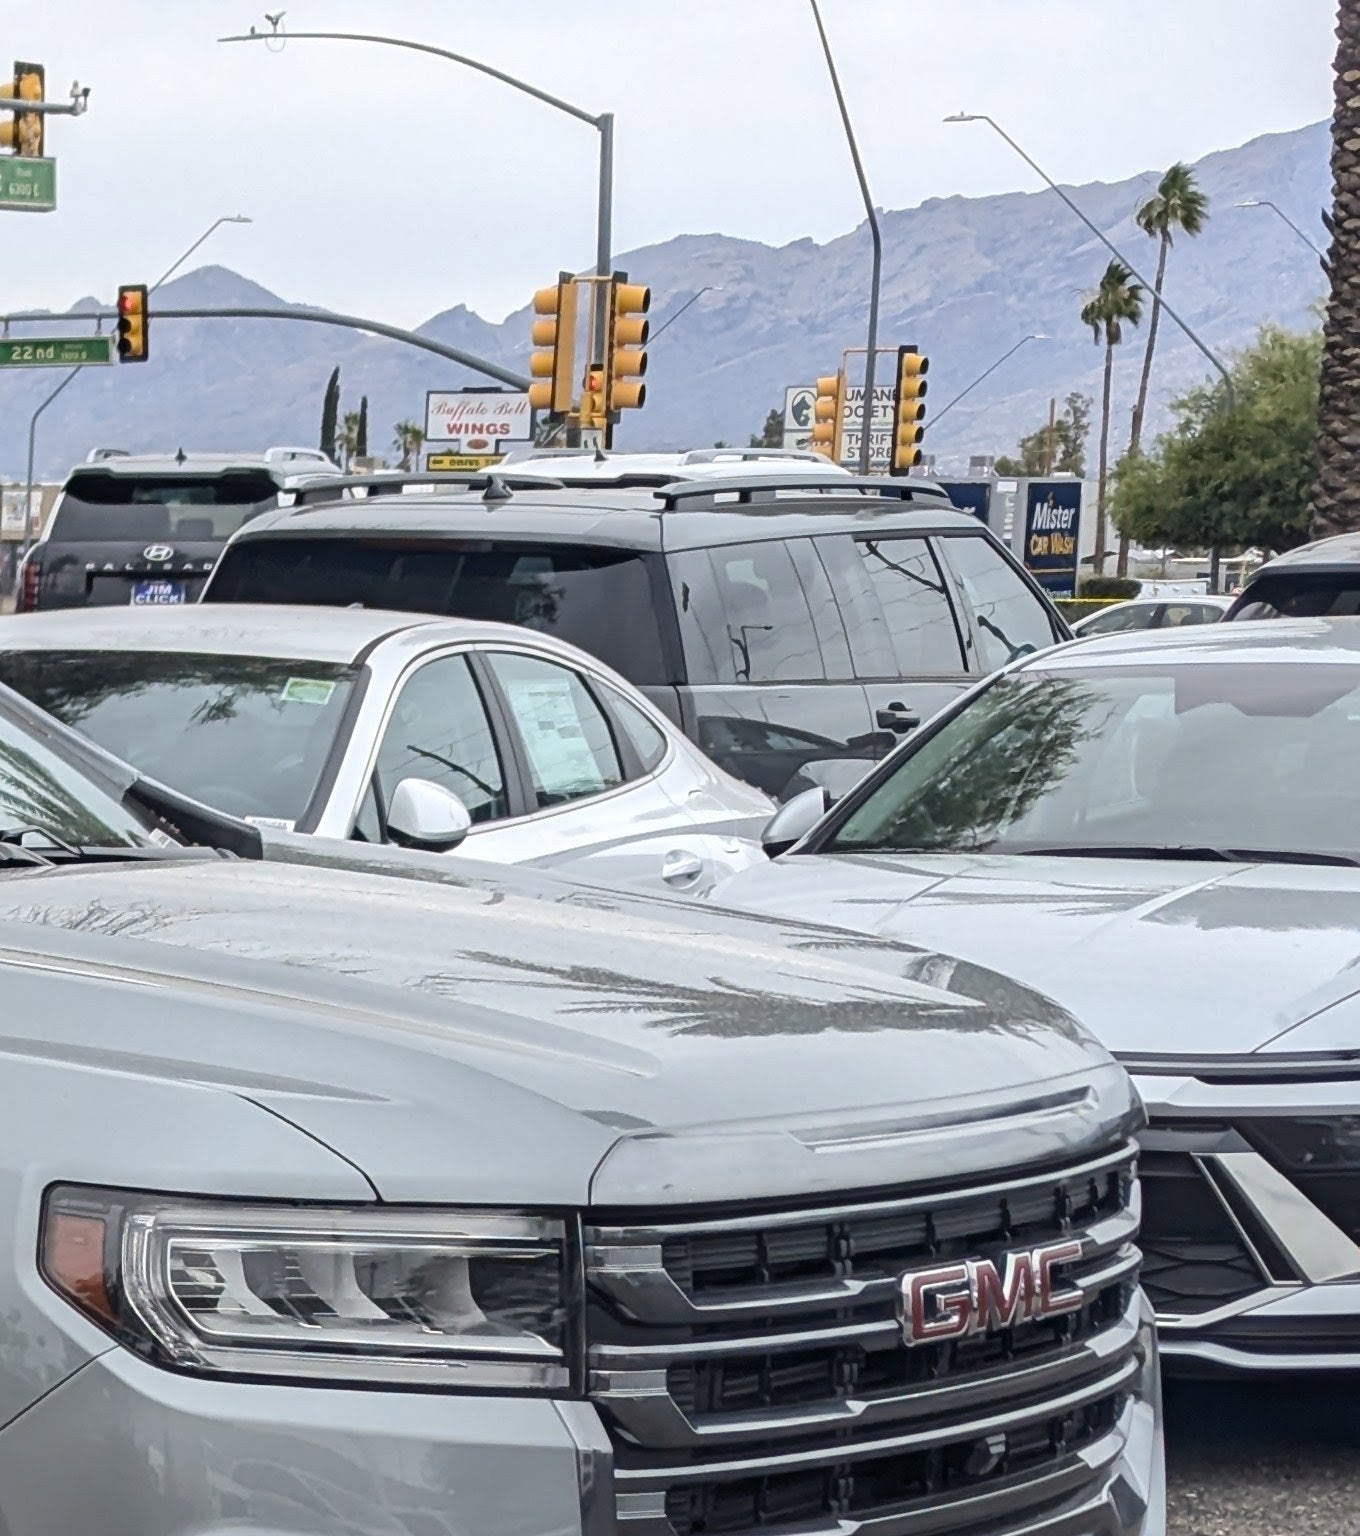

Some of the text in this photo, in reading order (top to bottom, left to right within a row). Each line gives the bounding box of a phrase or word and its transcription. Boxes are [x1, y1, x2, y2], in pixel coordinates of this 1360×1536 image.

[11, 345, 54, 360] 22nd
[844, 389, 897, 402] UMANE
[431, 401, 488, 421] Buffalo
[843, 405, 894, 418] OCET
[446, 423, 511, 435] WINGS
[1032, 502, 1076, 530] Mister
[85, 563, 214, 571] PALISAD
[145, 583, 173, 595] JIM
[135, 594, 179, 604] CLICK
[900, 1239, 1085, 1347] GMC
